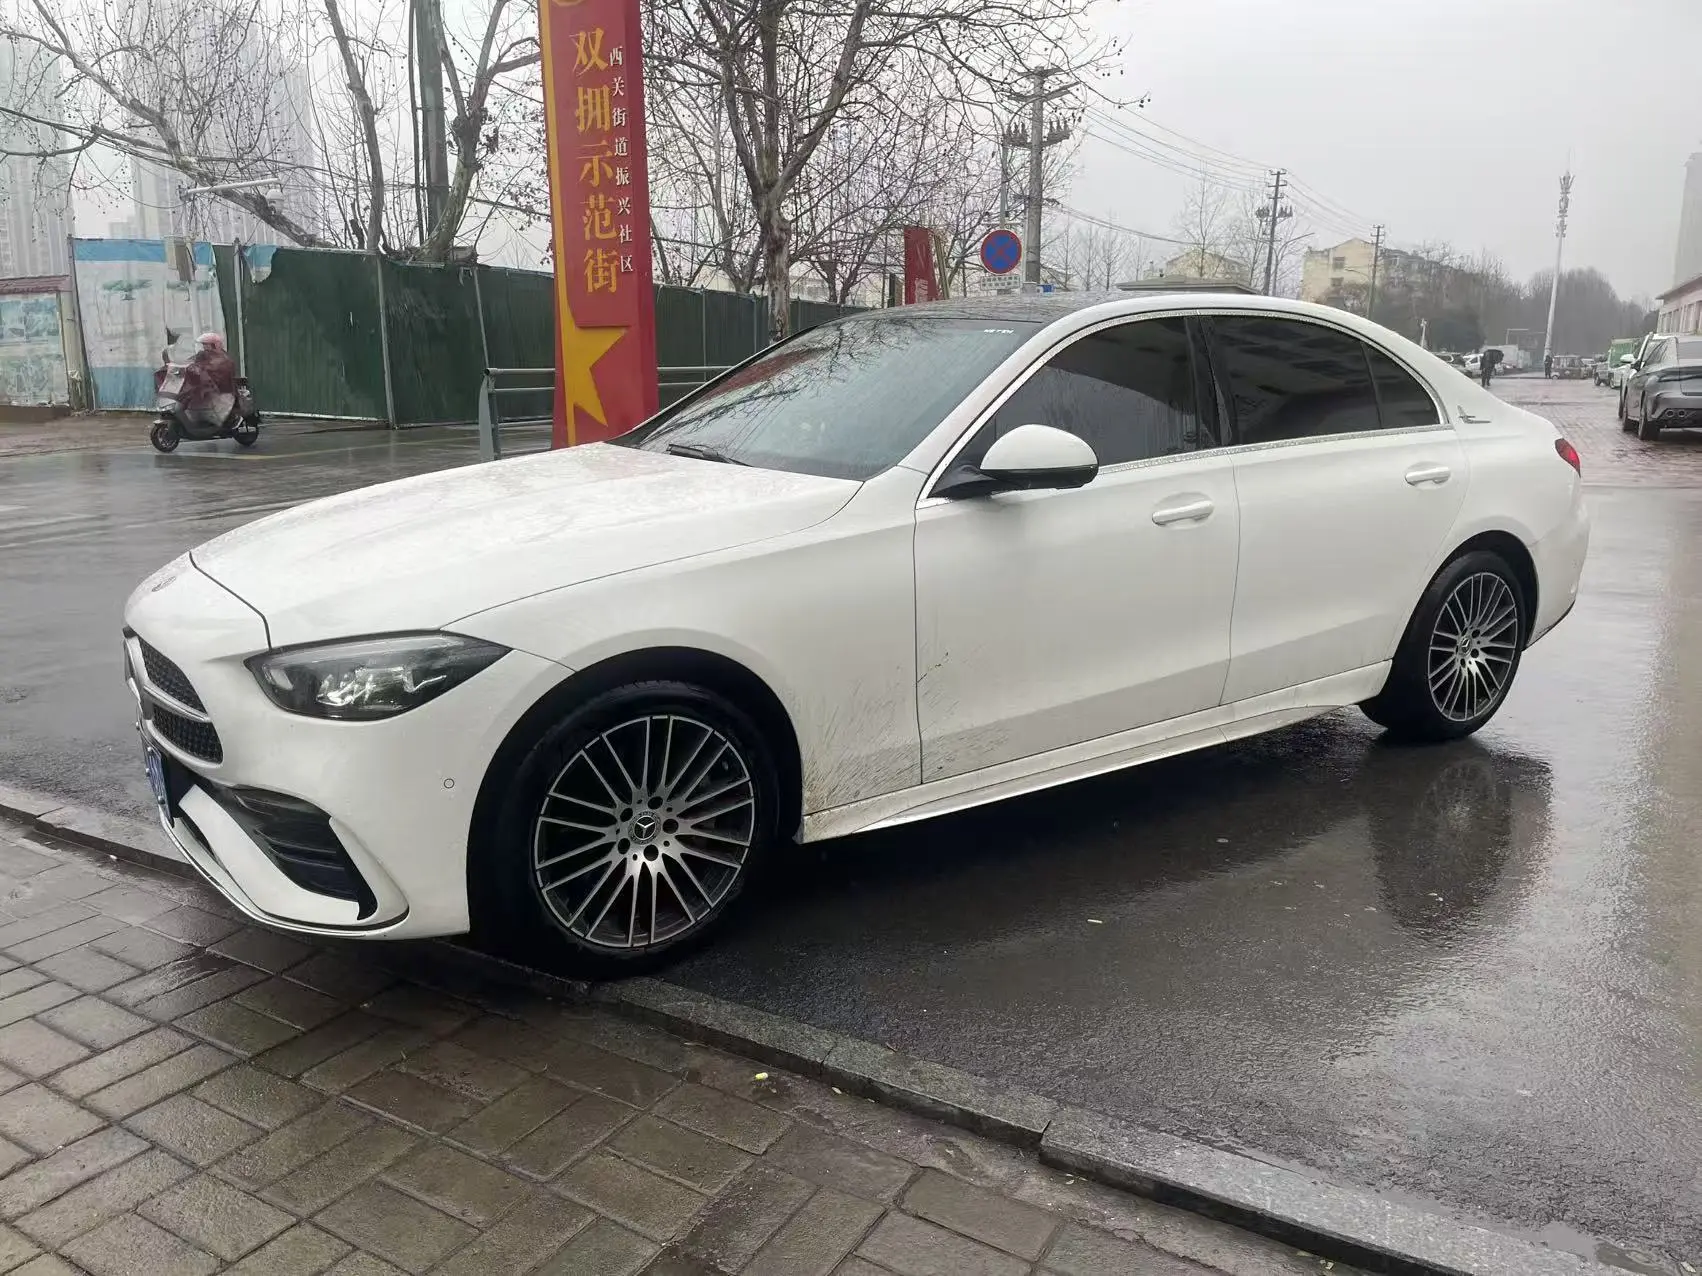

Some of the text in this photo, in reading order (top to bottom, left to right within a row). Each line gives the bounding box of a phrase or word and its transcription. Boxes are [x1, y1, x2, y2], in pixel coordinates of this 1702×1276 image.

[569, 27, 618, 293] 双拥示范街
[609, 46, 634, 273] 西关街道振兴社区
